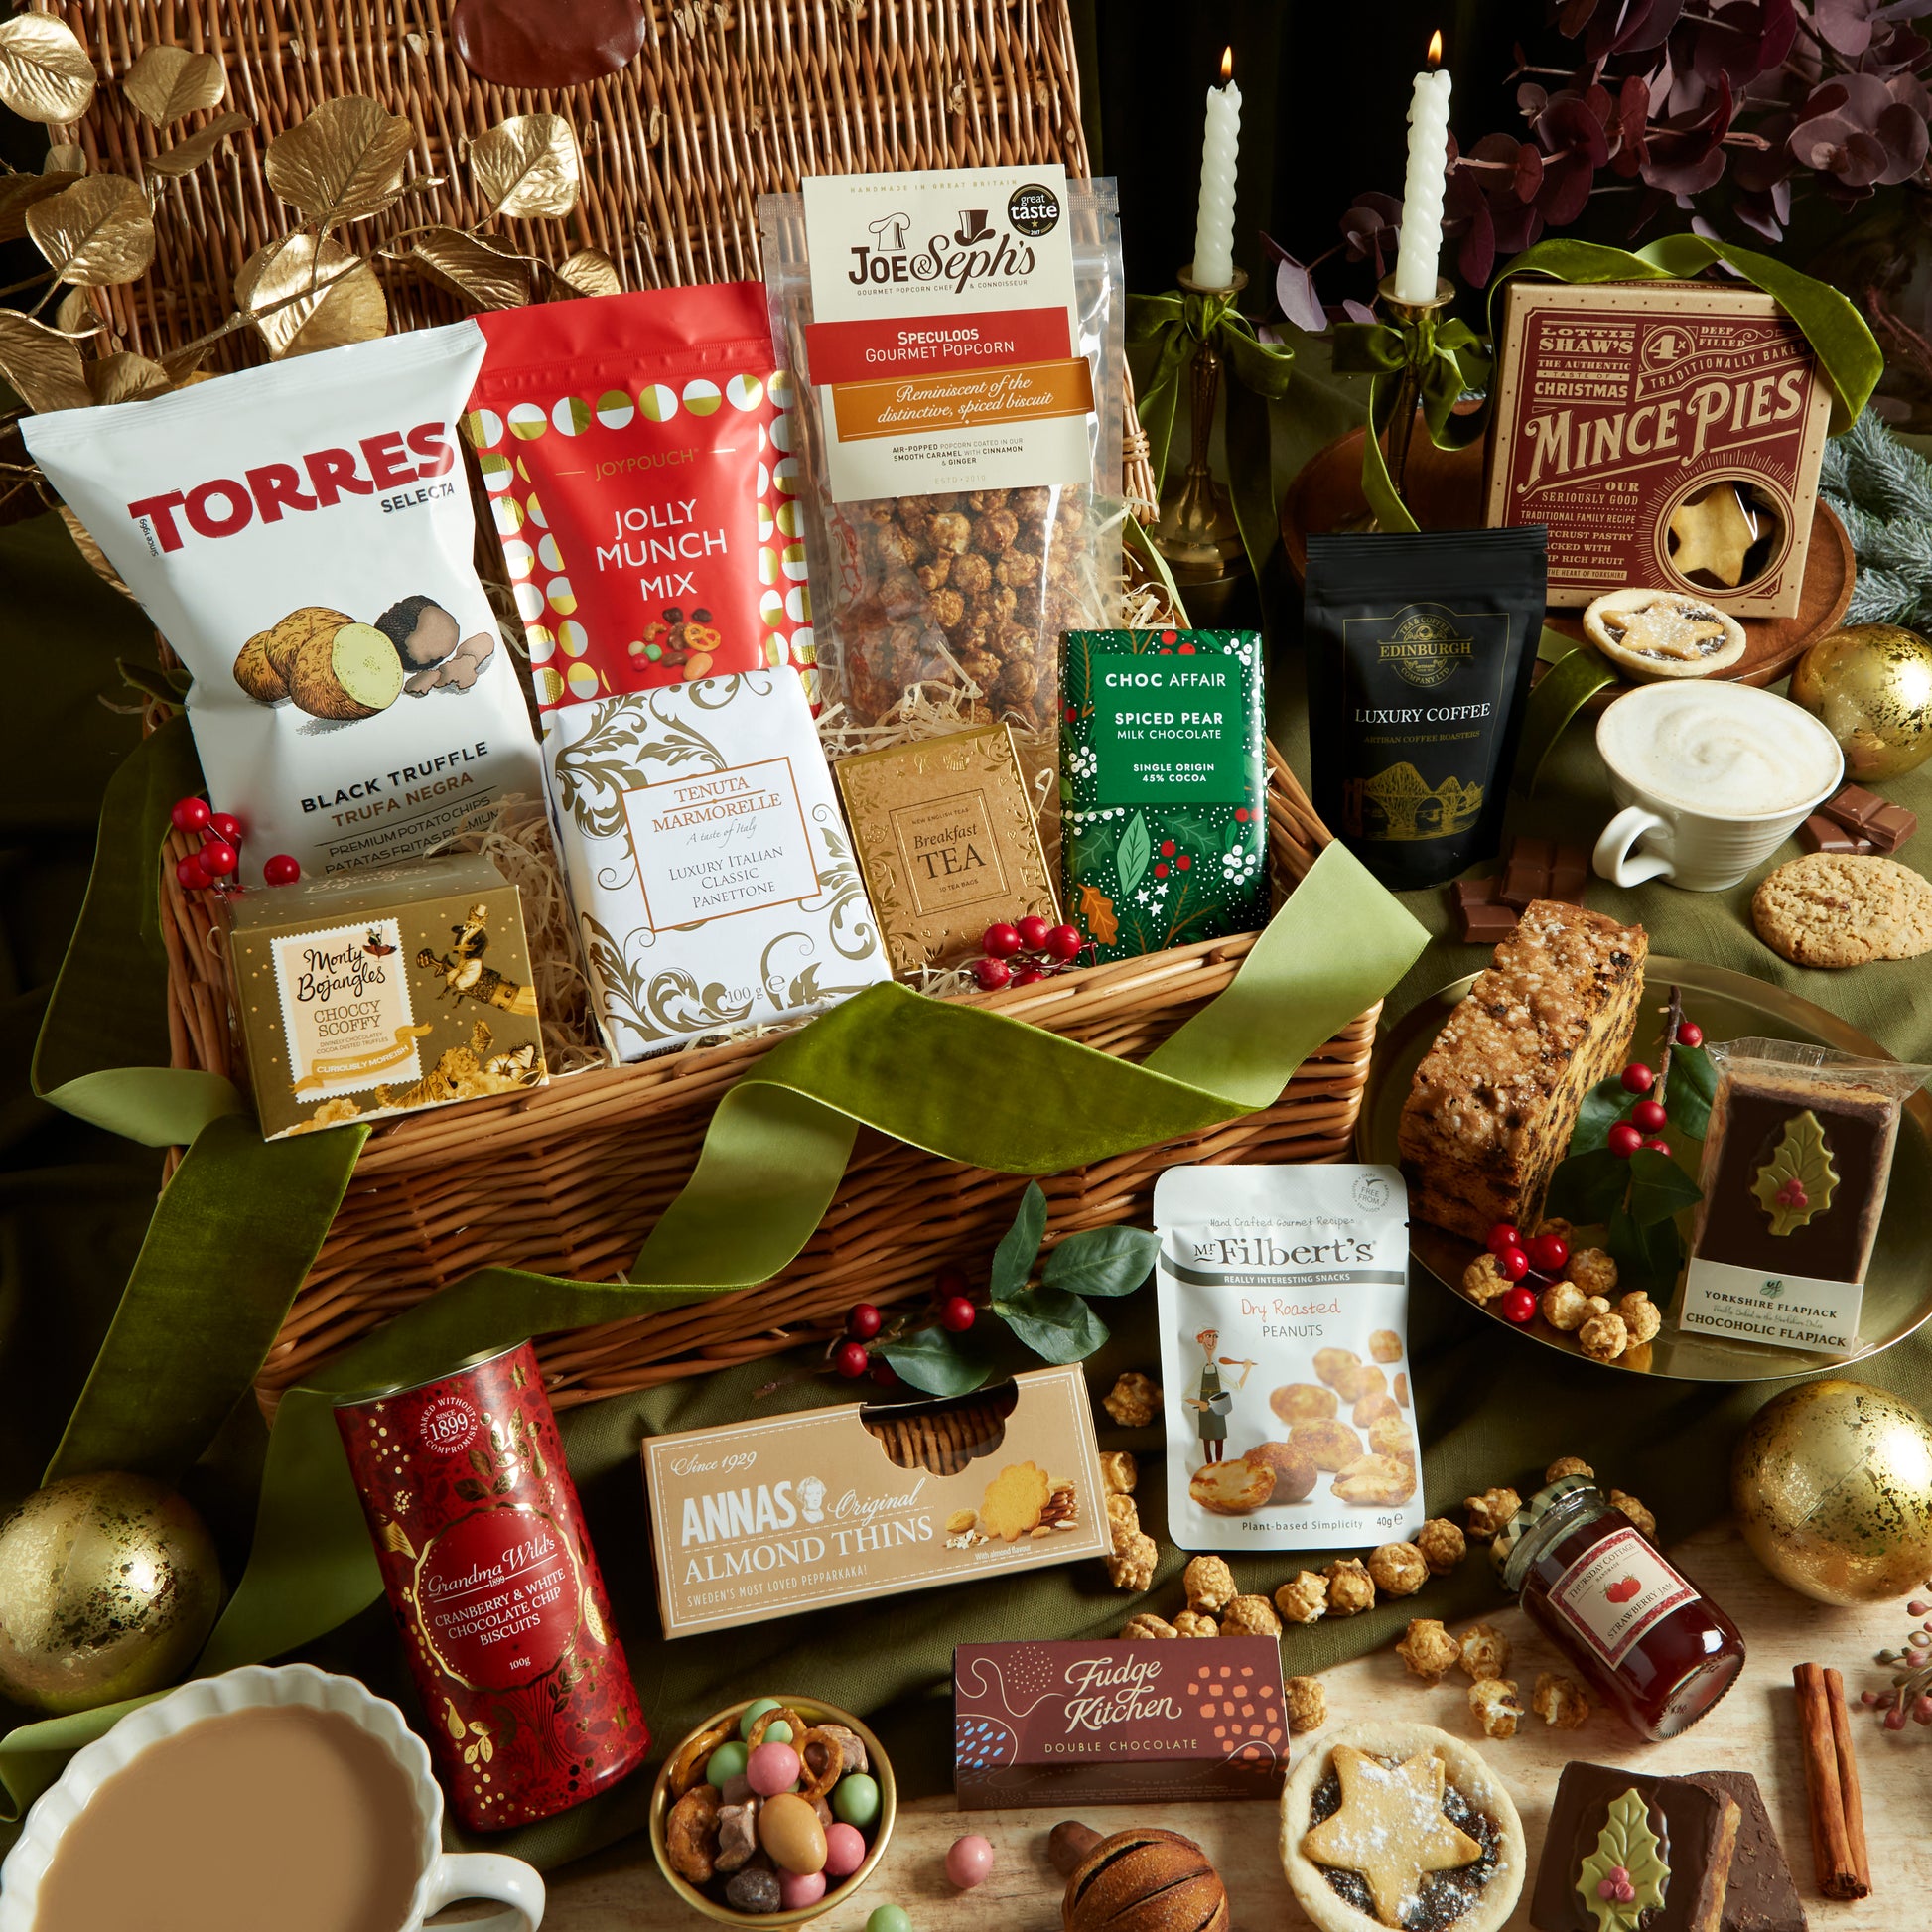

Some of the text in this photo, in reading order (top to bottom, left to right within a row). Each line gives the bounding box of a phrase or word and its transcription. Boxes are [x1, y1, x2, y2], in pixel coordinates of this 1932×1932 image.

[851, 184, 908, 193] HANDMADE
[1021, 194, 1045, 206] great
[1011, 204, 1057, 219] taste
[848, 247, 908, 285] JOE
[897, 329, 979, 345] SPECULOOS
[1541, 328, 1635, 338] LOTTIE
[1699, 338, 1745, 346] FILLED
[1701, 326, 1734, 335] DEEP
[865, 341, 1015, 362] GOURMET POPCORN
[1539, 338, 1634, 354] SHAW'S
[1565, 361, 1631, 370] AUTHENTIC
[1650, 353, 1755, 388] TRADITIONALLY
[897, 373, 1033, 403] Reminiscent the
[1535, 382, 1628, 397] CHRISTMAS
[877, 392, 1053, 423] distinctive, spiced biscuit
[1517, 369, 1805, 494] MINCE PIES
[893, 444, 938, 453] AIR-POPPED
[926, 450, 961, 459] CARAMEL
[982, 446, 1023, 455] CINNAMON
[595, 450, 694, 482] JOYPOUCH
[127, 421, 455, 554] TORRES
[381, 483, 455, 514] SELECTA
[1542, 492, 1638, 505] SERIOUSLY GOOD
[1605, 482, 1639, 492] OUR
[615, 499, 697, 540] JOLLY
[1521, 511, 1635, 524] TRADITIONAL FAMILY RECIPE
[596, 528, 728, 572] MUNCH
[640, 572, 697, 601] MIX
[1380, 642, 1471, 657] EDINBURGH
[1105, 673, 1226, 687] CHOC AFFAIR
[1115, 712, 1223, 725] SPICED PEAR
[1355, 703, 1490, 724] LUXURY COFFEE
[1117, 730, 1221, 739] MILK CHOCOLATE
[1403, 734, 1438, 743] COFFEE
[1440, 731, 1480, 741] ROASTERS
[301, 741, 488, 813] BLACK TRUFFLE
[674, 776, 750, 802] TENUTA
[1169, 773, 1206, 782] COCOA
[332, 771, 474, 827] TRUFA NEGRA
[652, 793, 782, 832] MARMORELLE
[927, 811, 953, 821] ENGLISH
[329, 812, 452, 857] PREMIUM POTATO
[701, 830, 720, 841] taste
[914, 823, 978, 849] Breakfast
[325, 833, 442, 874] PATATAS FRITAS
[669, 847, 783, 881] LUXURY ITALIAN
[917, 843, 987, 880] TEA
[701, 868, 759, 889] CLASSIC
[961, 879, 979, 888] BAGS
[693, 881, 775, 908] PANETTONE
[303, 944, 364, 974] Monty
[297, 962, 385, 1002] Bojangles
[727, 988, 751, 1004] 100
[314, 1000, 381, 1023] CHOCCY
[319, 1015, 381, 1037] SCOFFY
[317, 1045, 409, 1073] CURIOUSLY MOREISH
[1358, 1194, 1380, 1204] FROM
[1361, 1187, 1379, 1197] FREE
[1234, 1217, 1272, 1226] Crafted
[1214, 1238, 1374, 1266] Filbert's
[1224, 1275, 1255, 1284] REALLY
[1242, 1298, 1341, 1322] Dry Roasted
[1705, 1290, 1773, 1310] YORKSHIRE
[1778, 1304, 1837, 1318] FLAPJACK
[1263, 1325, 1323, 1337] PEANUTS
[1686, 1313, 1775, 1335] CHOCOHOLIC
[1780, 1329, 1847, 1347] FLAPJACK
[430, 1413, 468, 1441] 1899
[436, 1409, 456, 1421] SINCE
[671, 1451, 757, 1476] Since 1929
[682, 1477, 926, 1547] ANNAS Original
[1242, 1520, 1363, 1532] Plant-based Simplicity
[683, 1515, 933, 1586] ALMOND THINS
[428, 1533, 555, 1597] Grandma Wild's
[1569, 1543, 1636, 1598] THURSDAY COTTAGE
[489, 1576, 505, 1587] 1899
[687, 1564, 868, 1607] SWEDEN'S MOST LOVED PEPPARKAKA!
[435, 1568, 566, 1626] CRANBERRY & WHITE
[449, 1587, 561, 1639] CHOCOLATE CHIP
[1608, 1583, 1674, 1639] STRAWBERRY JAM
[480, 1613, 541, 1646] BISCUITS
[510, 1657, 531, 1670] 100g
[1065, 1654, 1162, 1702] Fudge
[1064, 1685, 1182, 1734] Kitchen
[1044, 1739, 1198, 1754] DOUBLE CHOCOLATE
